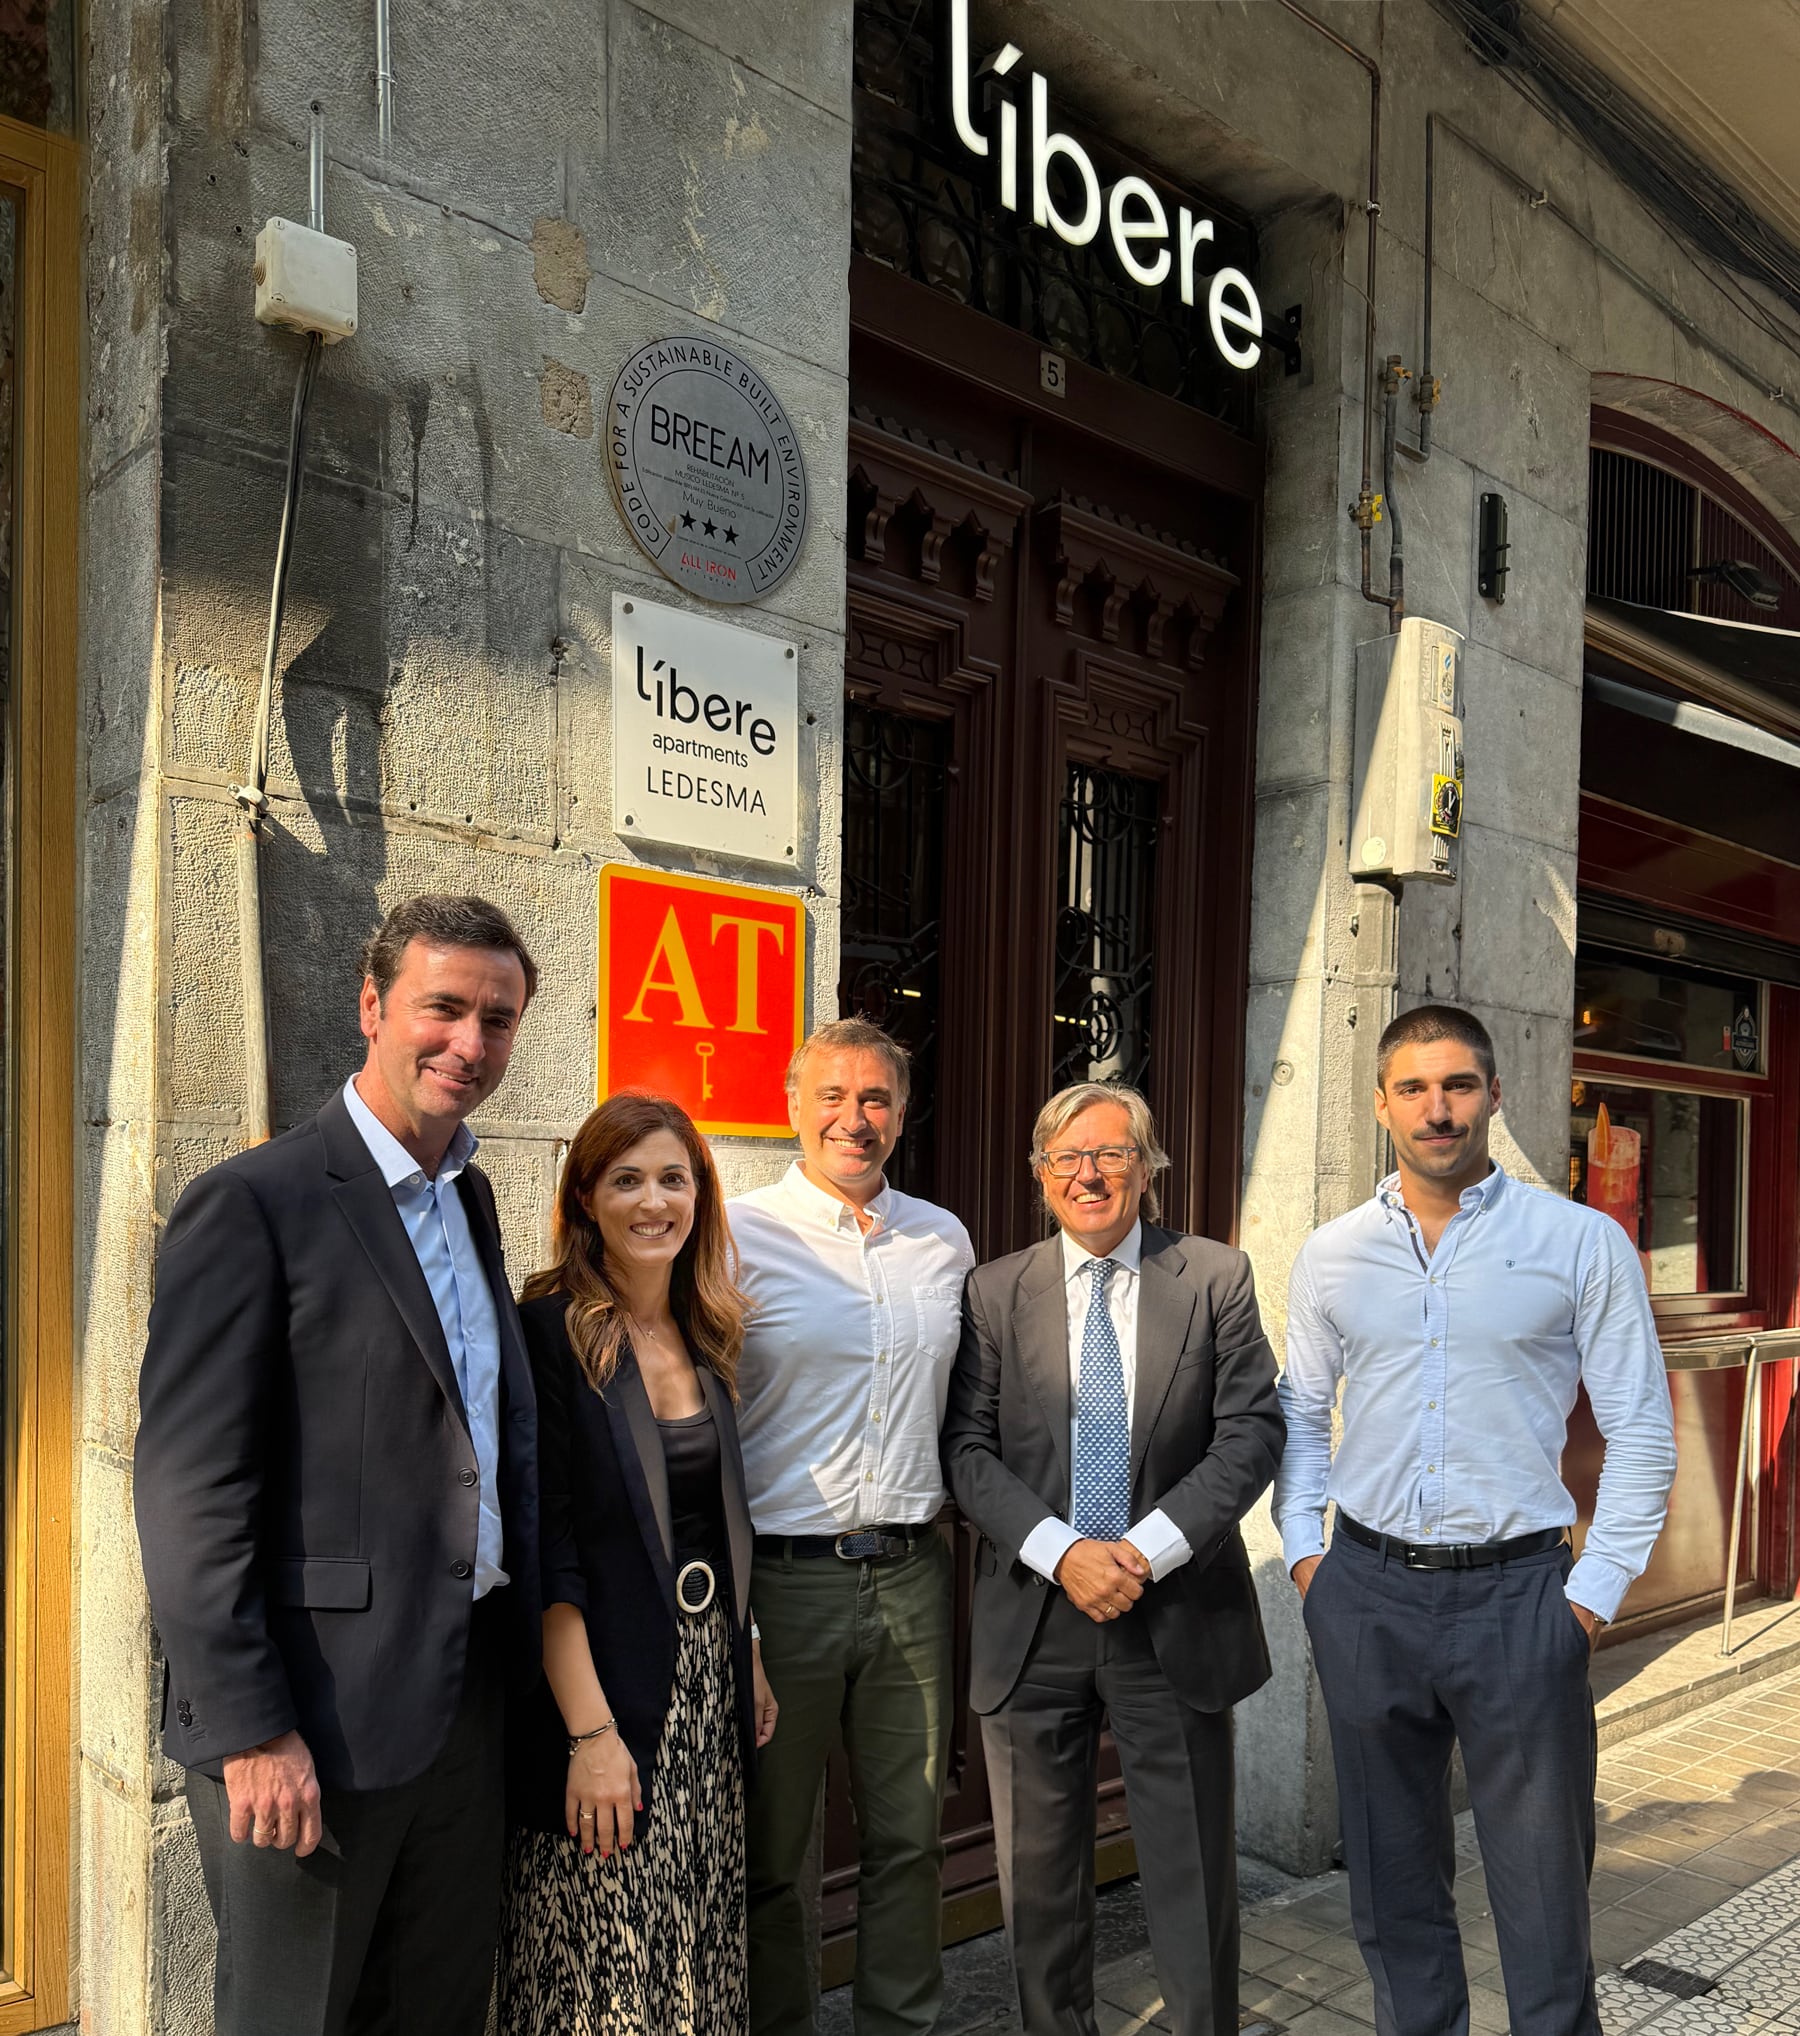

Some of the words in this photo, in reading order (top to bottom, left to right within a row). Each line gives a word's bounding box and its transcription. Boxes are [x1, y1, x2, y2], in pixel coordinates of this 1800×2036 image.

[951, 0, 1263, 370] líbere
[624, 346, 733, 400] SUSTAINABLE
[739, 371, 782, 426] BUILT
[1048, 360, 1058, 386] 5
[617, 402, 630, 418] A
[613, 426, 629, 469] FOR
[651, 404, 769, 484] BREEAM
[683, 491, 703, 508] Muy
[707, 500, 737, 518] Bueno
[702, 478, 730, 494] LEDESMA
[758, 435, 800, 580] ENVIRONMENT
[622, 482, 660, 543] CODE
[681, 552, 701, 569] ALL
[706, 560, 736, 580] IRON
[637, 645, 776, 755] líbere
[652, 732, 748, 768] apartments
[647, 766, 767, 816] LEDESMA
[624, 904, 784, 1035] AT
